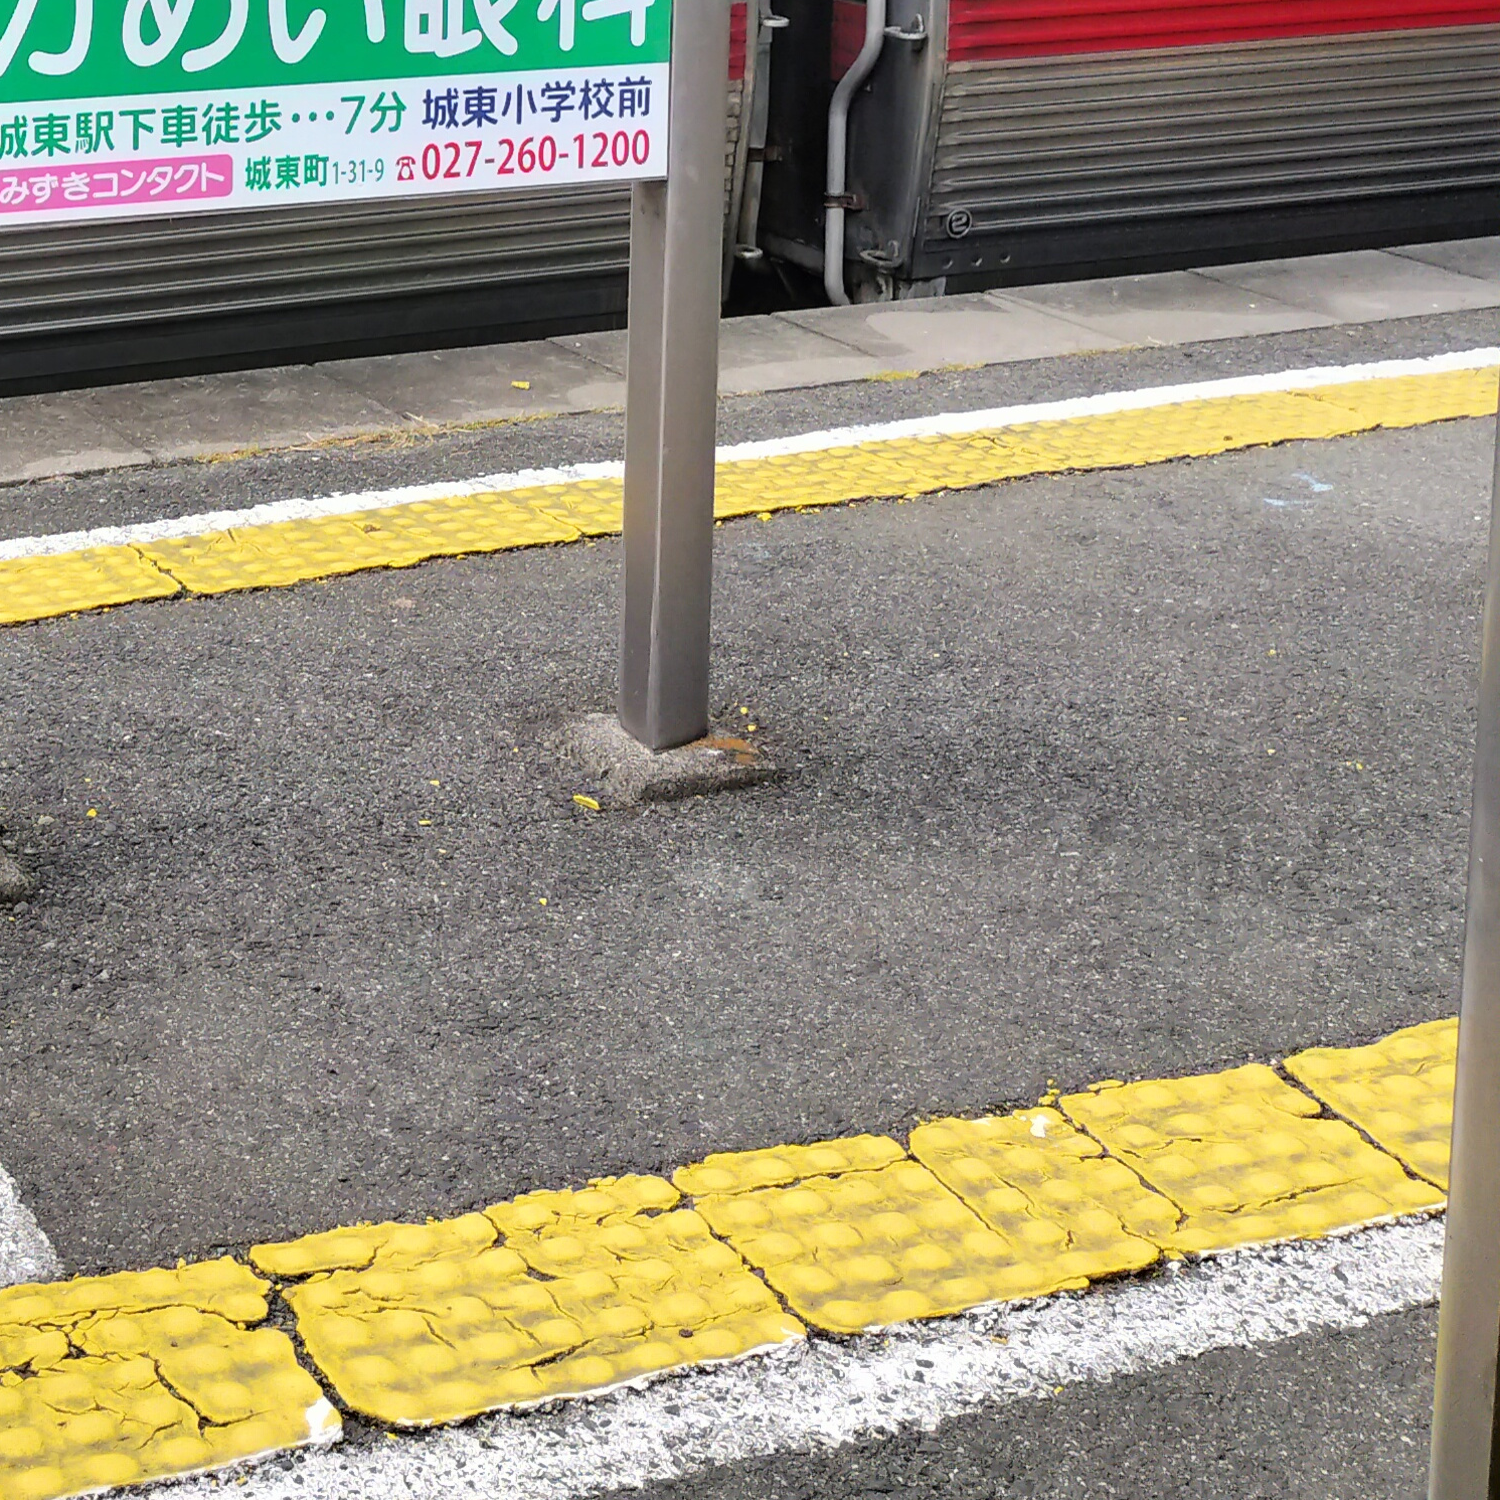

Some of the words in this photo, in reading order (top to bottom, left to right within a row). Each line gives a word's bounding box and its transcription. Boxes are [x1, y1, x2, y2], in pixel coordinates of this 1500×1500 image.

[421, 76, 653, 130] 城東小学校前
